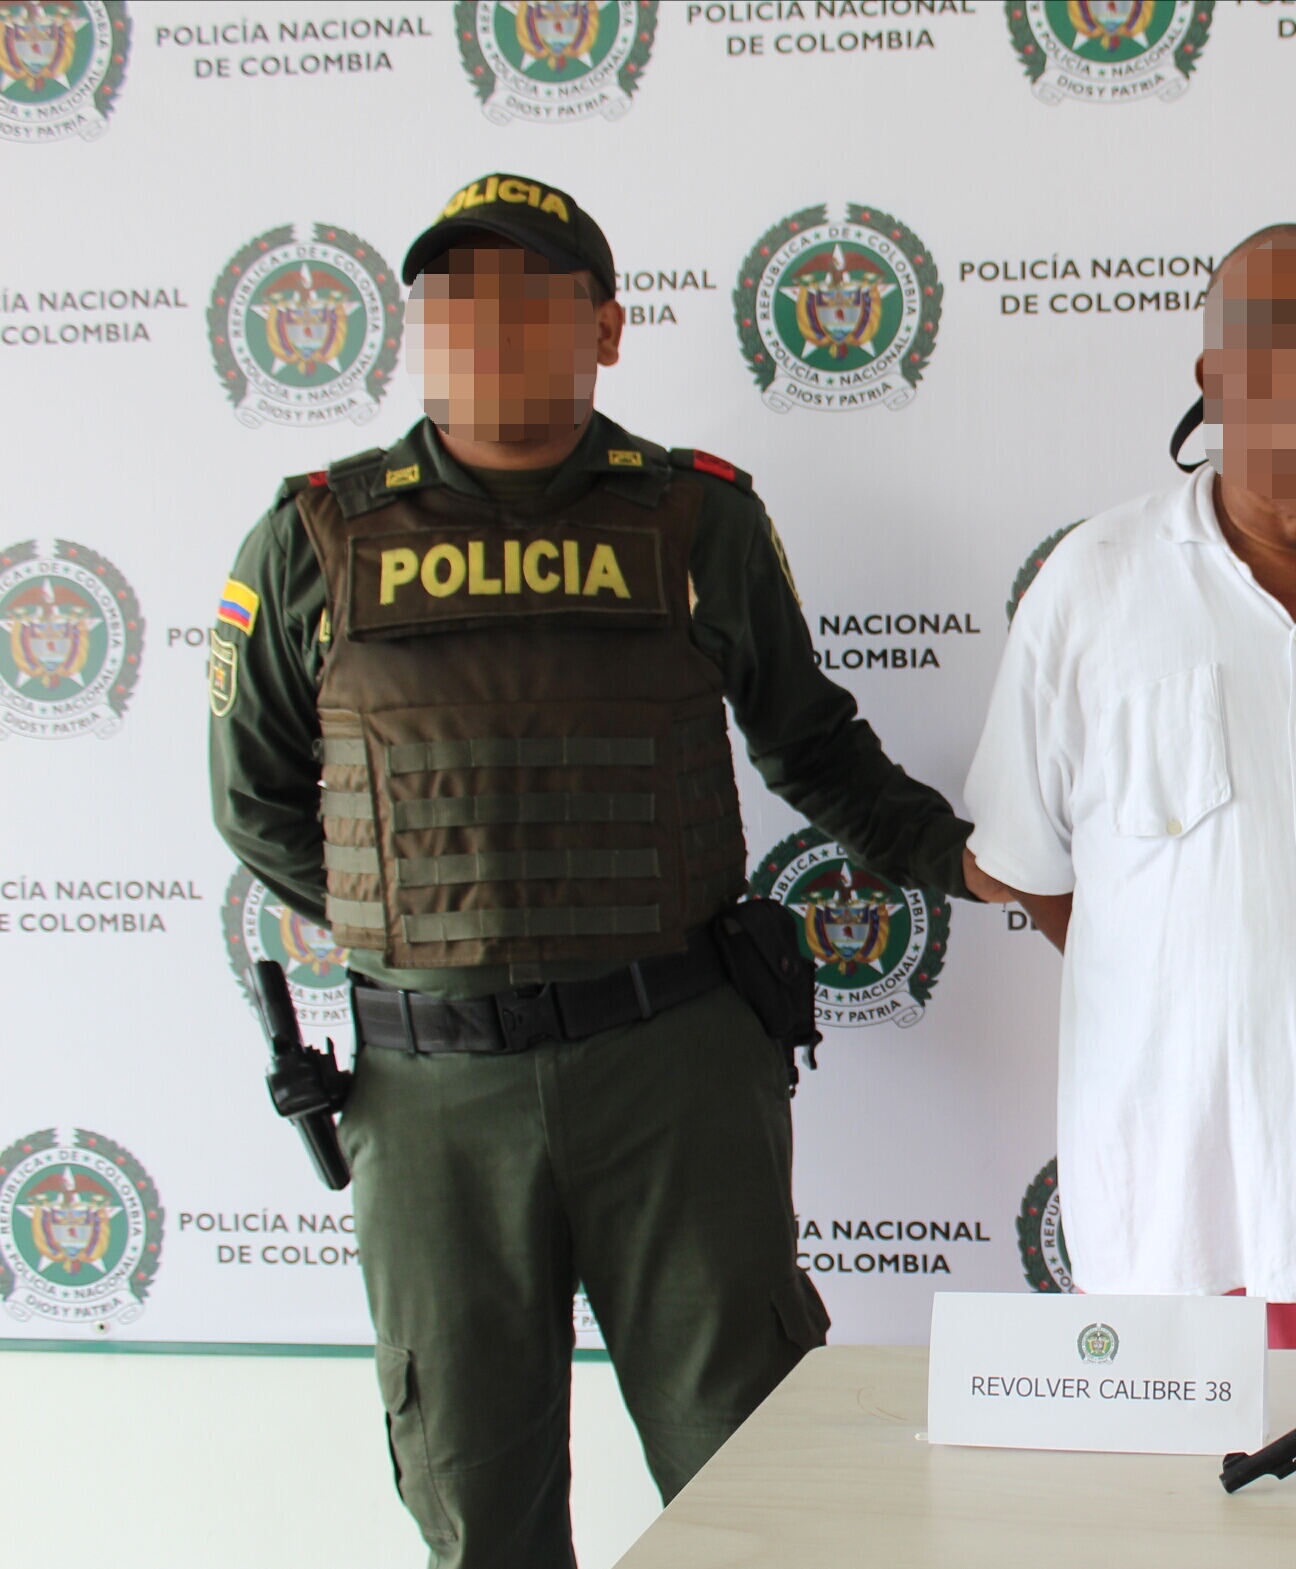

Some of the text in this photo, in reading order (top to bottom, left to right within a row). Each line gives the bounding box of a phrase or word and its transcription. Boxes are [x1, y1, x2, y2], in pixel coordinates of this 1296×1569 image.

[815, 0, 975, 20] NACIONAL
[156, 17, 433, 46] POLICÍA NACIONAL
[727, 29, 935, 56] DE COLOMBIA
[1112, 28, 1183, 77] NACIONAL
[194, 51, 393, 79] DE COLOMBIA
[830, 228, 850, 238] DE
[868, 235, 916, 316] COLOMBIA
[959, 254, 1213, 282] POLICÍA NACION
[616, 269, 717, 292] IONAL
[38, 289, 187, 312] NACIONAL
[1001, 294, 1038, 315] DE
[2, 322, 151, 345] COLOMBIA
[840, 336, 910, 385] NACIONAL
[840, 383, 892, 405] PATRIA
[379, 539, 632, 605] POLICIA
[819, 614, 981, 636] NACIONAL
[56, 880, 203, 902] NACIONAL
[19, 913, 167, 933] COLOMBIA
[849, 955, 918, 1002] NACIONAL
[849, 1000, 901, 1021] PATRIA
[179, 1208, 289, 1233] POLICÍA
[832, 1221, 992, 1242] NACIONAL
[217, 1244, 361, 1266] DE COLOM
[971, 1375, 1233, 1402] REVOLVER CALIBRE 38
